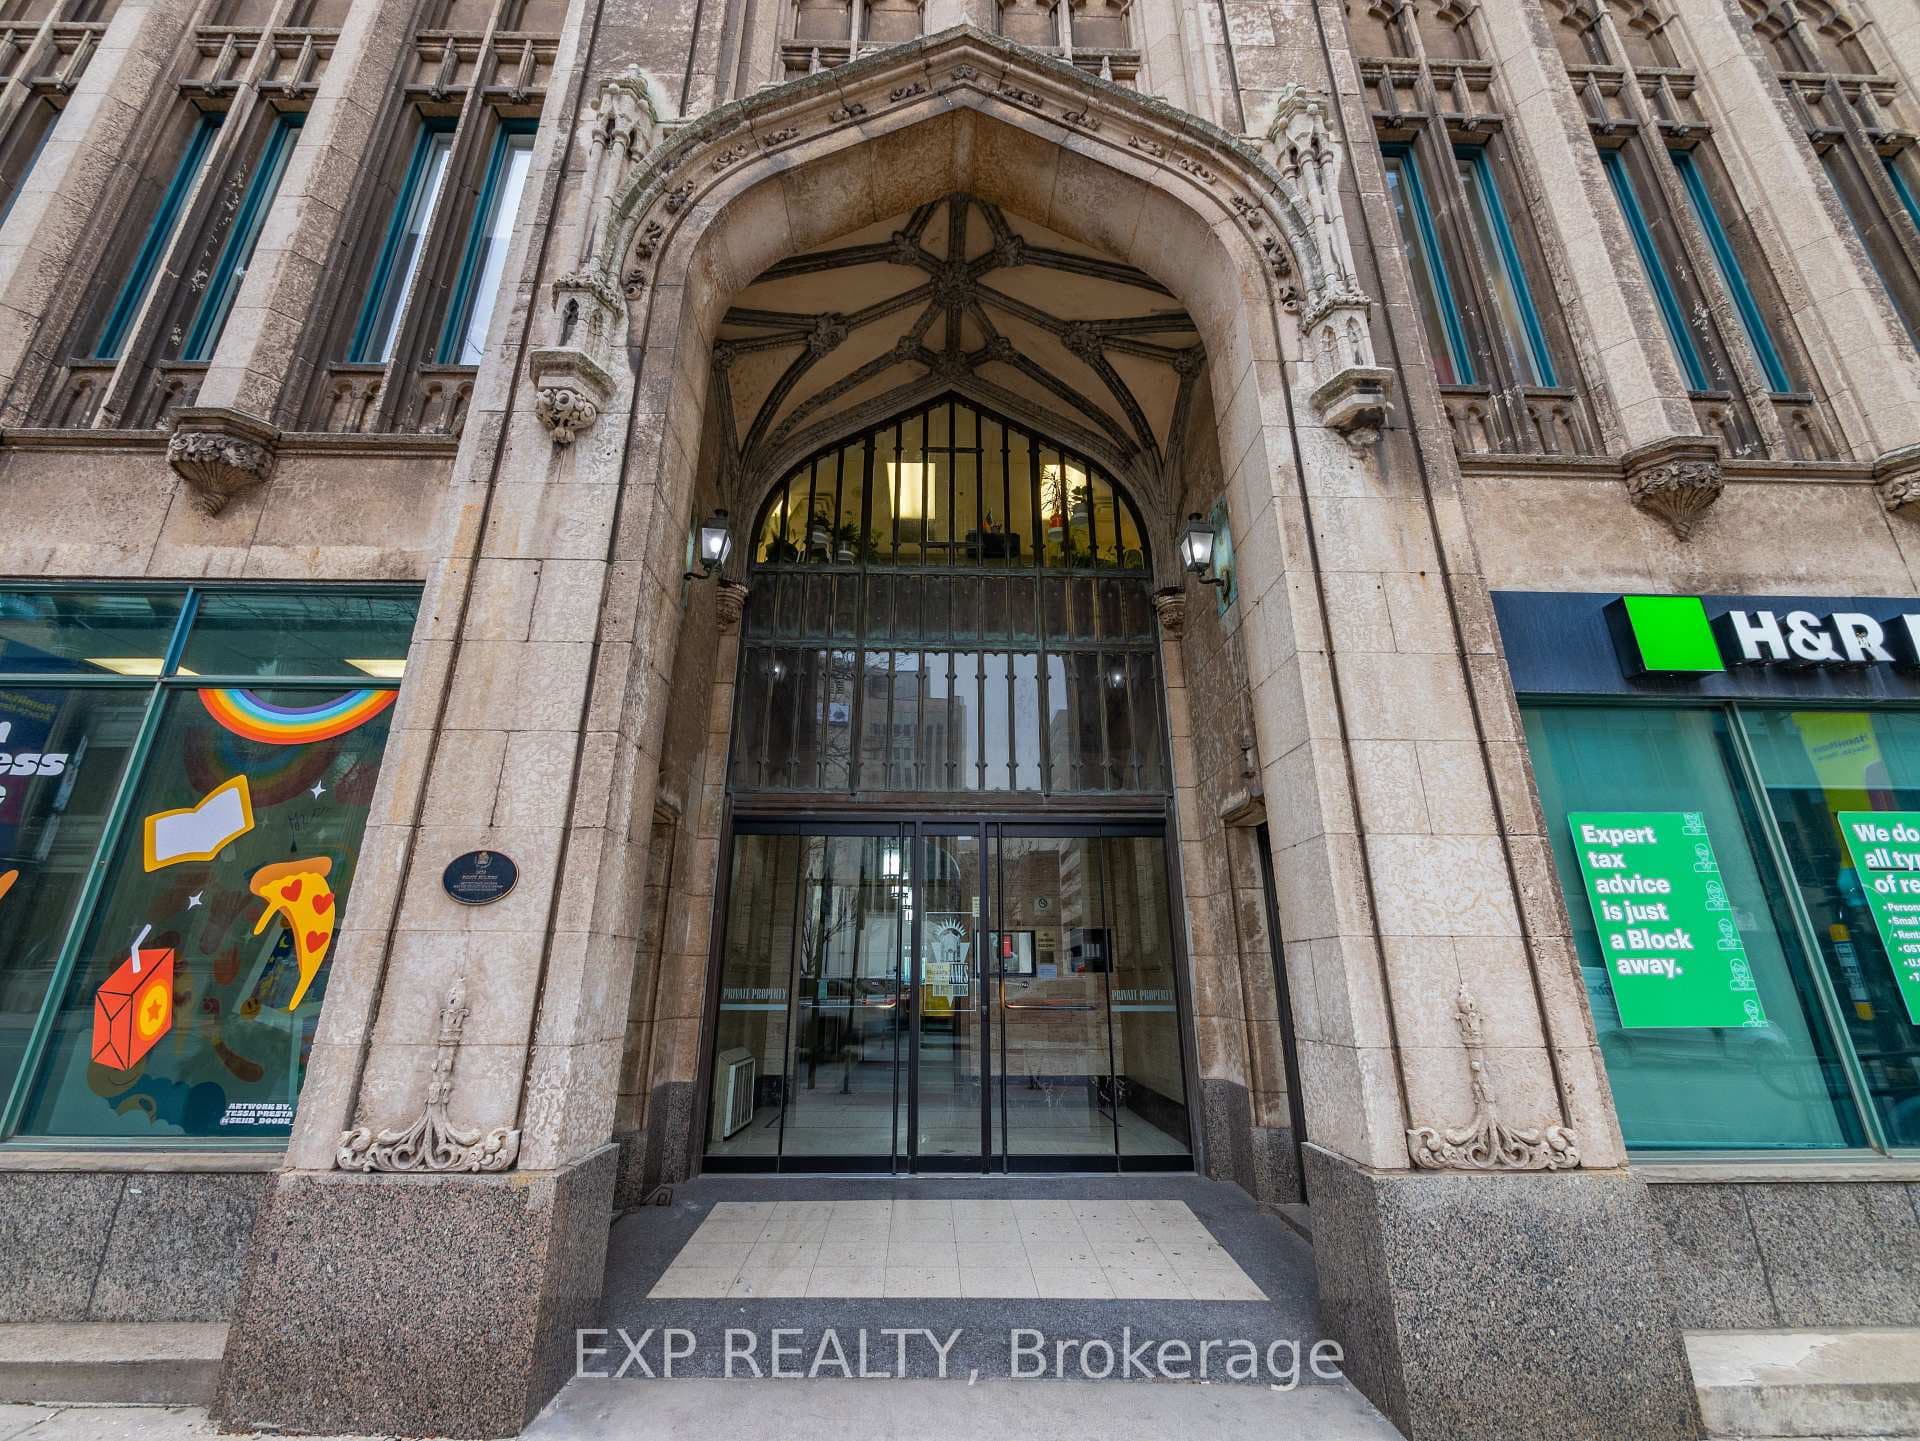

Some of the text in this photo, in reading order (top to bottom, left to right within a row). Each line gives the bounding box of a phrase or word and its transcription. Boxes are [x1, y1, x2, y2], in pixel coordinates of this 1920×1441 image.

[1729, 610, 1896, 662] H&R
[1581, 825, 1656, 846] Expert
[1853, 823, 1920, 842] We do
[1588, 852, 1626, 868] tax
[1865, 849, 1891, 867] all
[1596, 873, 1671, 894] advice
[1875, 874, 1897, 893] of
[1601, 900, 1669, 924] is just
[1611, 928, 1694, 949] a Block
[1617, 958, 1682, 979] away.
